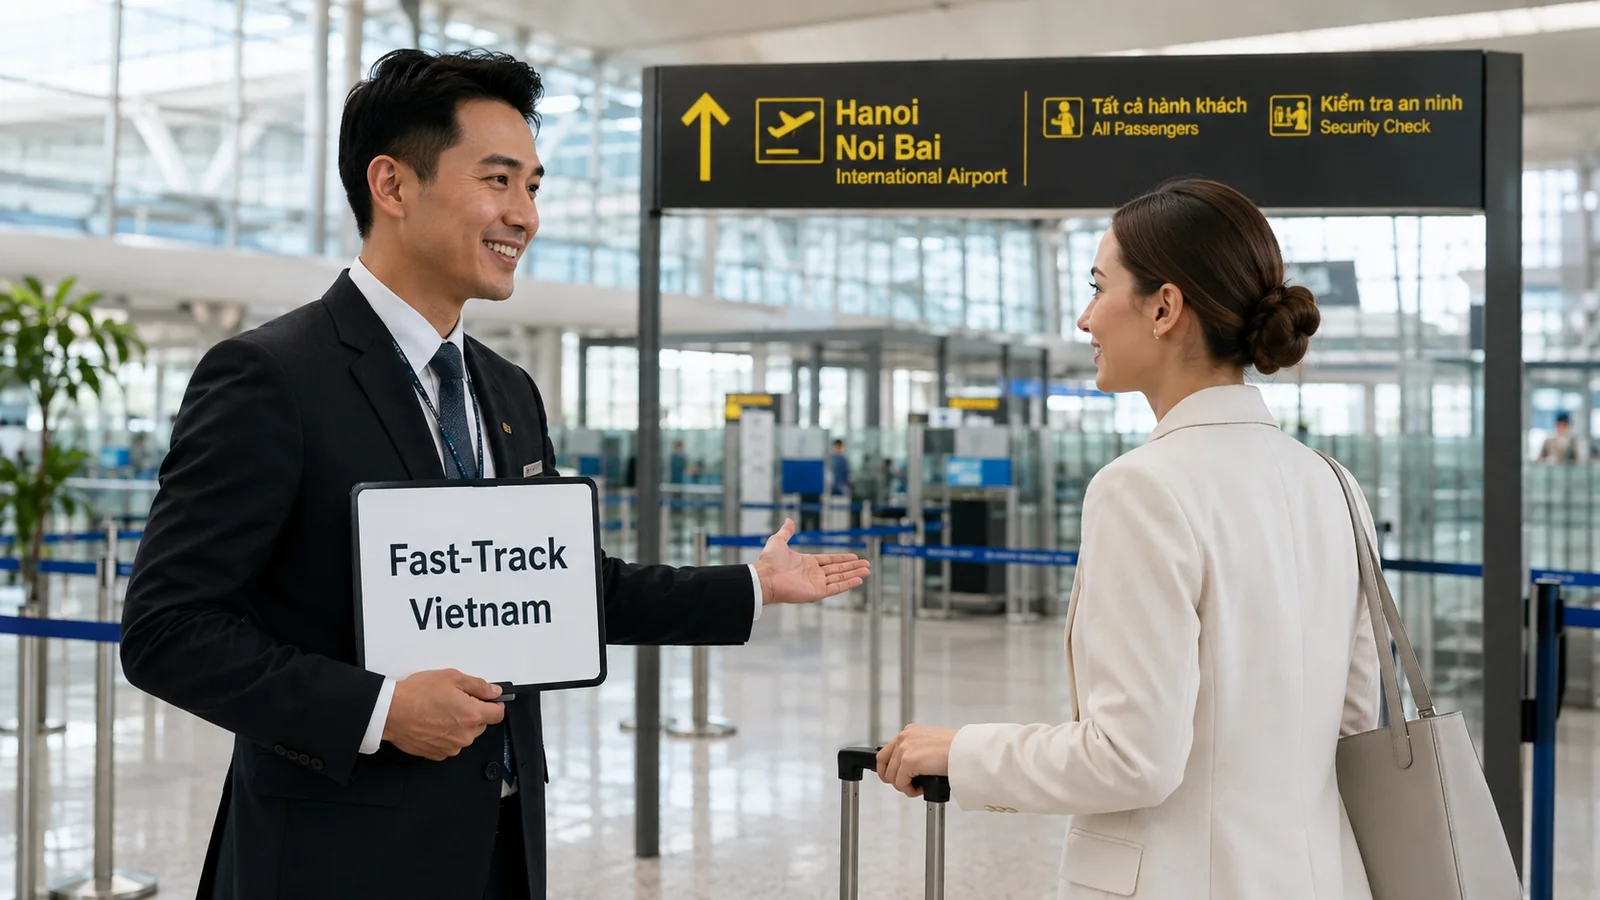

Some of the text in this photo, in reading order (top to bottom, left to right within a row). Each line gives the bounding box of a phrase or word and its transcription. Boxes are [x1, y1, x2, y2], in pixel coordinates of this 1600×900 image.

[836, 98, 919, 125] Hanoi
[1092, 95, 1248, 115] Tất cả hành khách
[1320, 93, 1464, 112] Kiểm tra an ninh
[1092, 120, 1200, 139] All Passengers
[1320, 118, 1431, 137] Security Check
[836, 133, 942, 161] Noi Bai
[836, 167, 1008, 188] International Airport
[390, 537, 568, 576] Fast-Track
[409, 596, 552, 631] Vietnam
